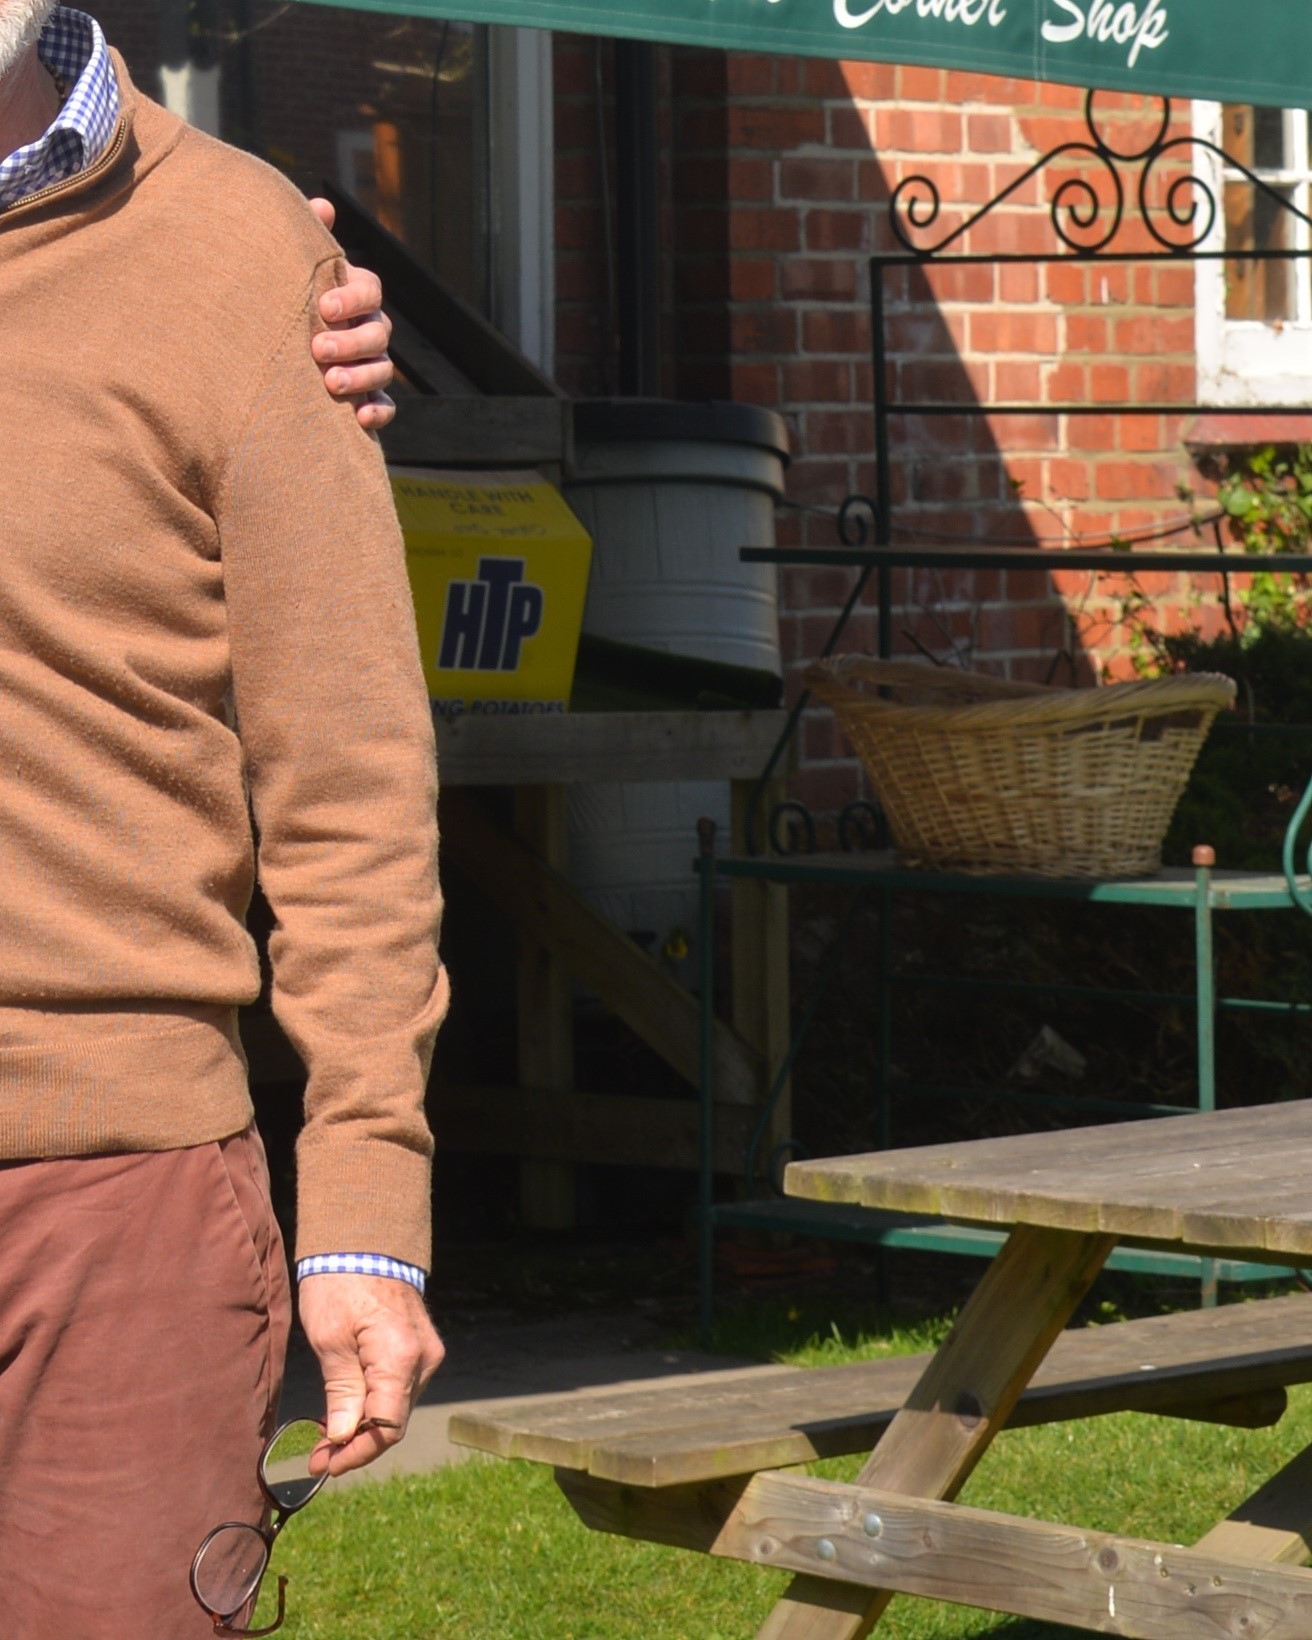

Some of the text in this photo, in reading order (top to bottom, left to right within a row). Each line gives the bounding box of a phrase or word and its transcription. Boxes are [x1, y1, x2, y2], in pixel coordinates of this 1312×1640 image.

[400, 484, 535, 503] HANDLE WITH
[449, 502, 504, 517] CARE
[437, 556, 543, 672] HTP
